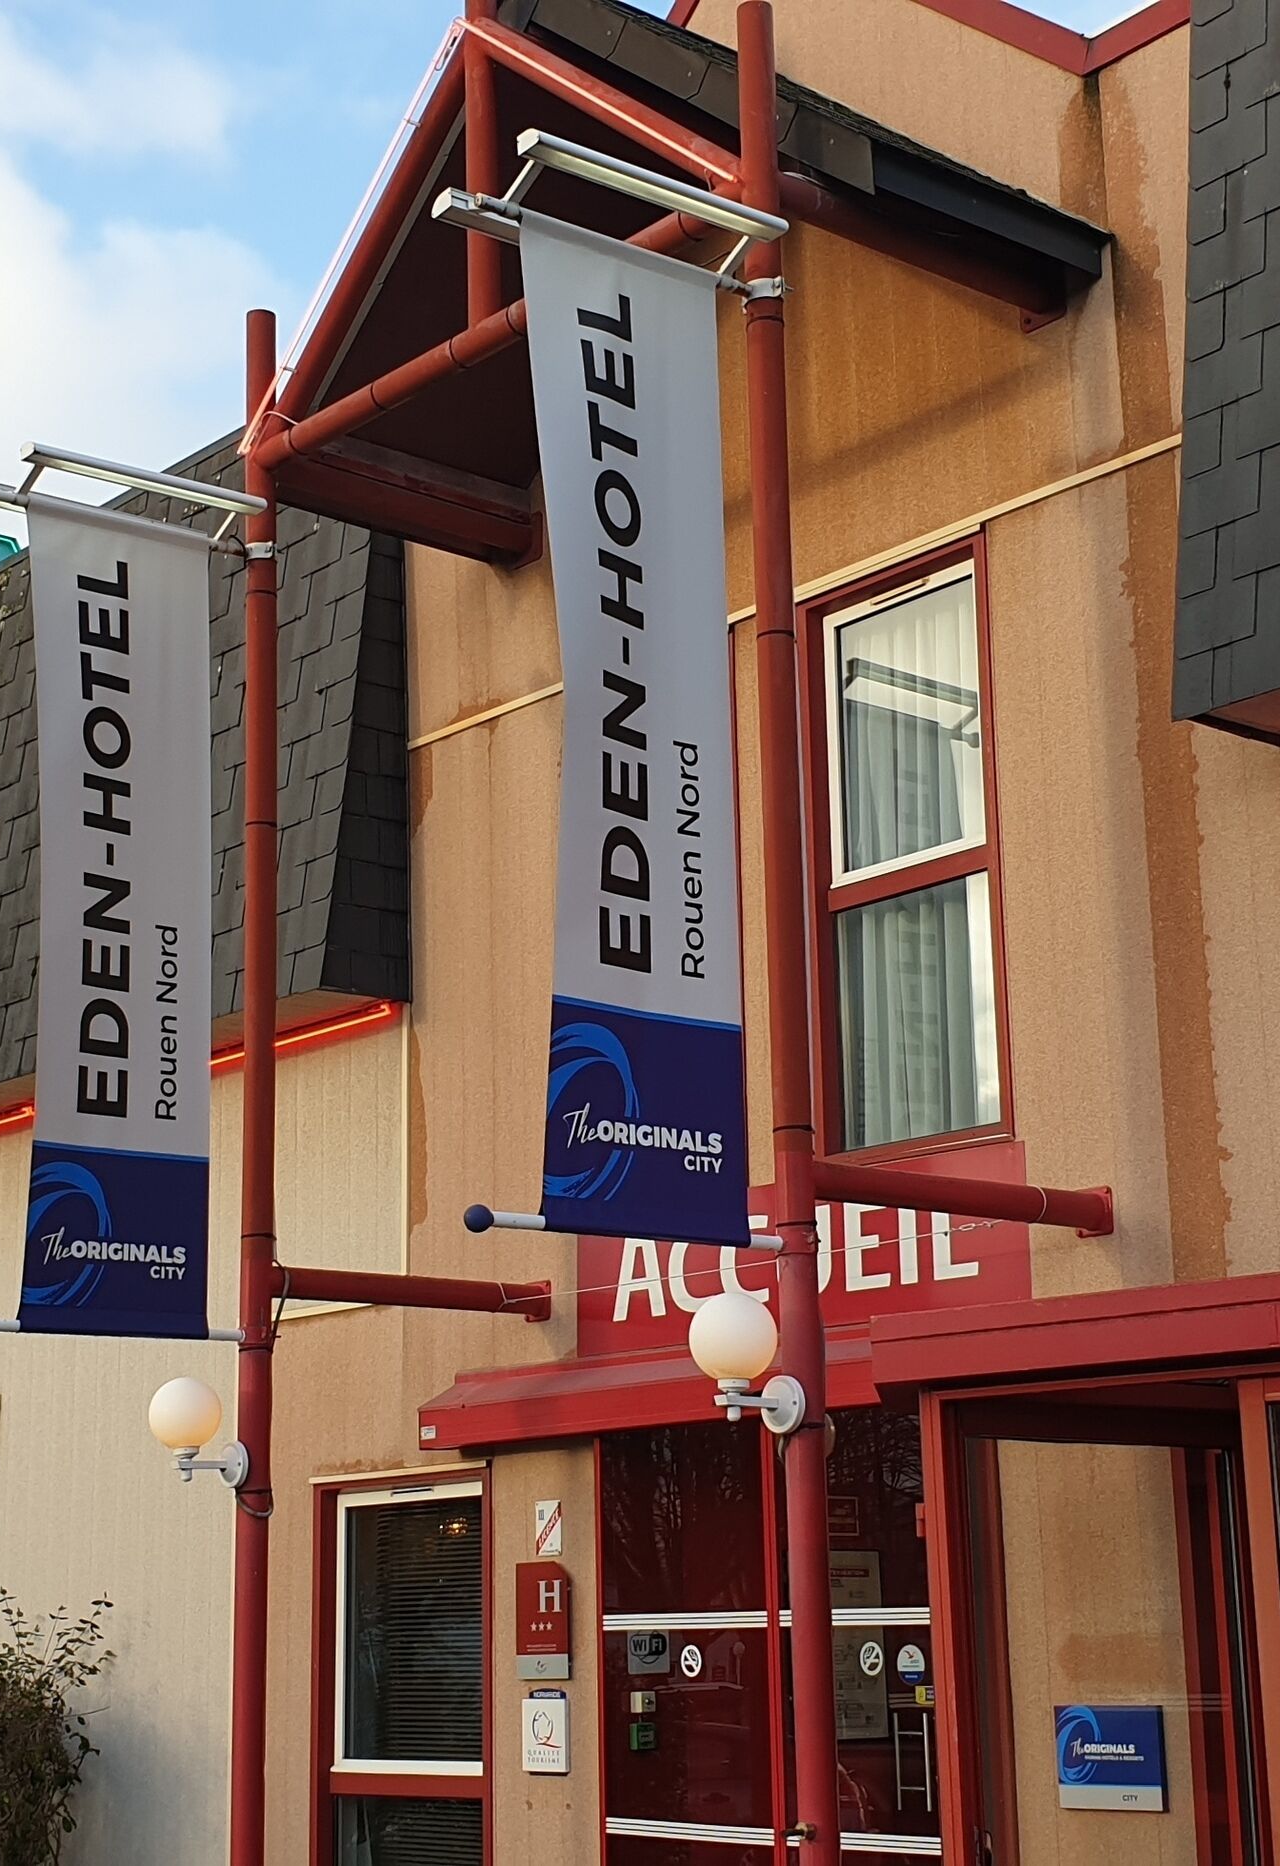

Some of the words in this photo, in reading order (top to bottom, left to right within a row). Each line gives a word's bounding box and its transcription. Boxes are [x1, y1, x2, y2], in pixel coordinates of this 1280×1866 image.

[577, 294, 651, 974] EDEN-HOTEL
[672, 740, 700, 838] Nord
[77, 561, 131, 1119] EDEN-HOTEL
[681, 852, 705, 980] Rouen
[154, 924, 178, 1005] Nord
[155, 1015, 178, 1121] Rouen
[562, 1102, 599, 1149] The
[596, 1119, 723, 1155] ORIGINALS
[683, 1155, 723, 1174] CITY
[40, 1226, 73, 1265] The
[70, 1240, 187, 1265] ORIGINALS
[150, 1265, 186, 1280] CITY
[537, 1579, 563, 1613] H
[1083, 1743, 1136, 1754] ORIGINALS
[1122, 1794, 1138, 1802] CITY
